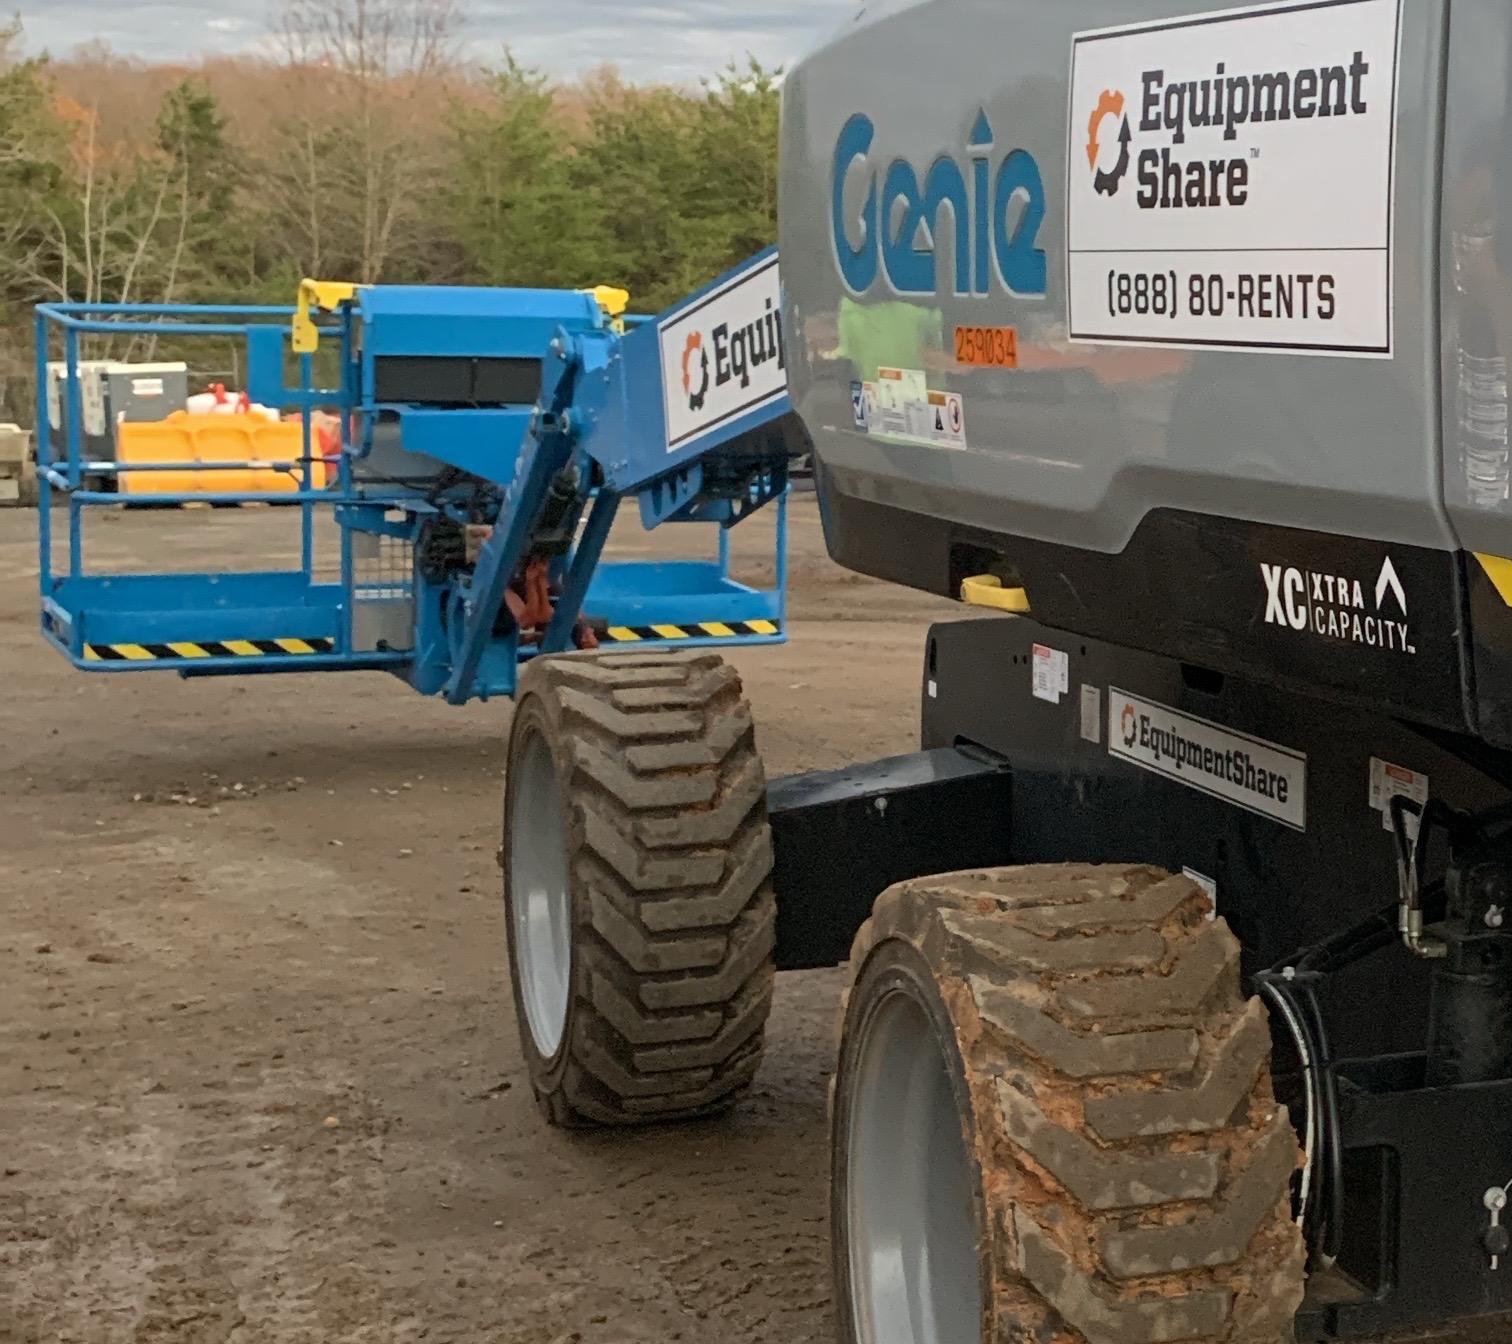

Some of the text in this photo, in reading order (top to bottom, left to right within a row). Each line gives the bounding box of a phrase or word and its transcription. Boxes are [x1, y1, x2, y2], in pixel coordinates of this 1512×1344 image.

[1139, 51, 1369, 144] Equipment
[832, 106, 1048, 300] Genie
[1137, 147, 1248, 209] Share
[1108, 269, 1336, 320] (888) 80-RENTS
[955, 327, 1017, 365] 259034
[1260, 562, 1307, 631] XC
[1311, 572, 1365, 610] XTRA
[1315, 606, 1408, 652] CAPACITY
[1139, 714, 1289, 804] EquipmentShare
